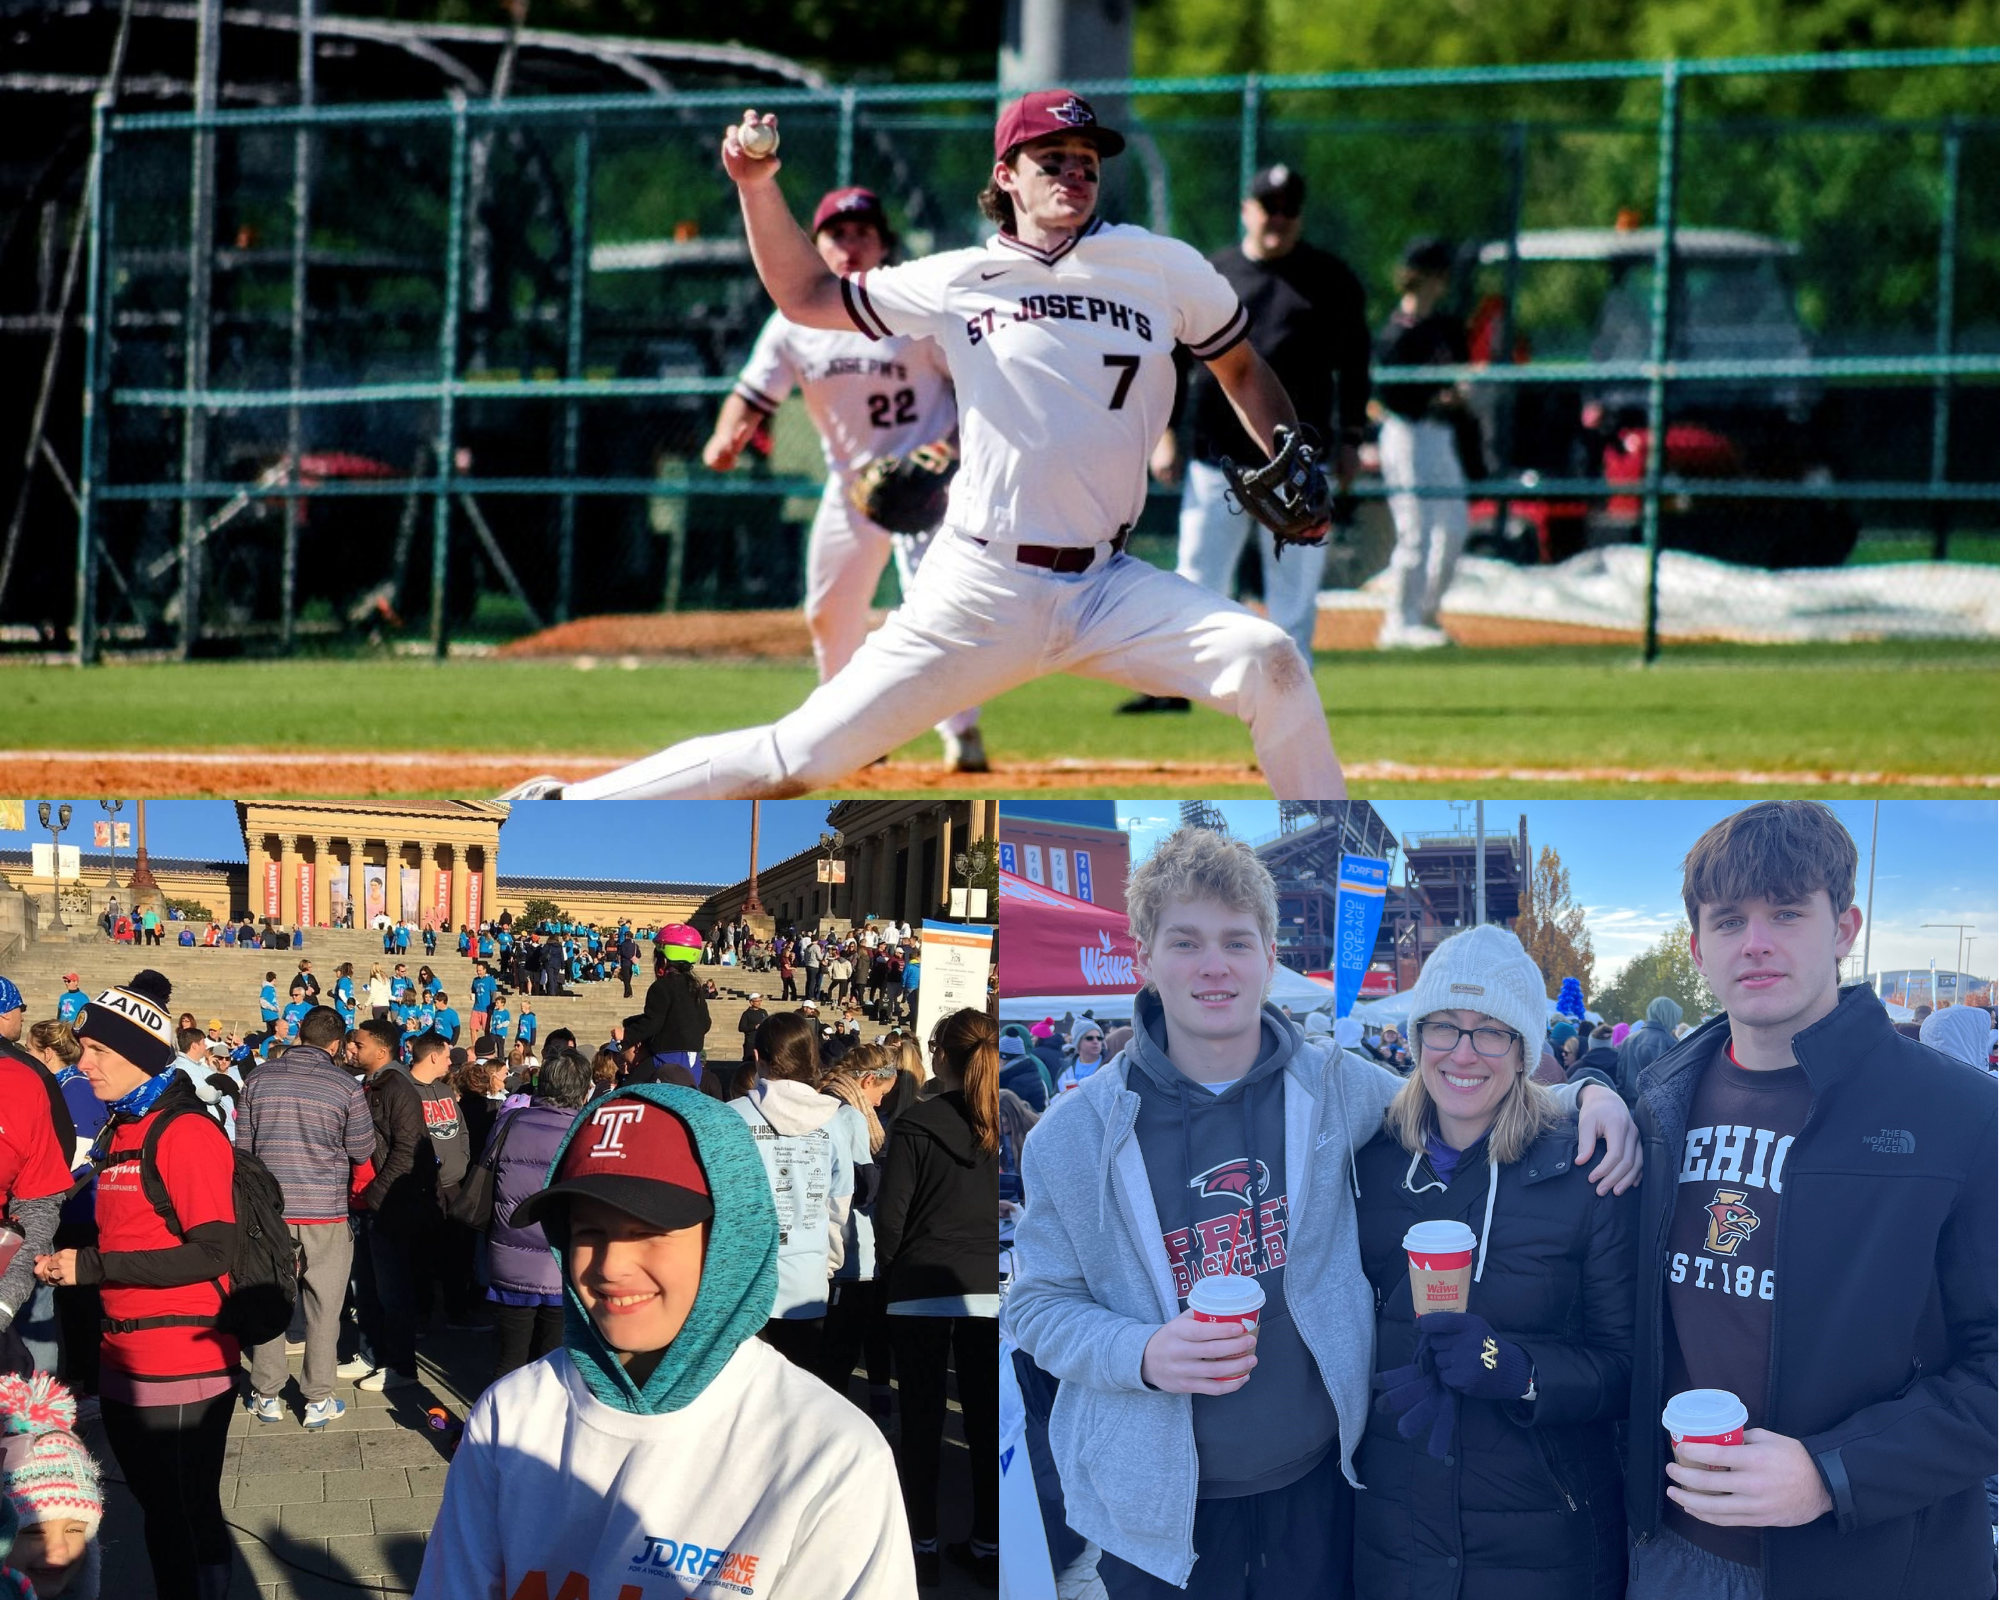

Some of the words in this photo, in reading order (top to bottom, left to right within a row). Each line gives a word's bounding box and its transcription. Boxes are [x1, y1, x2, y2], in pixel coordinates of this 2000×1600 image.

[966, 307, 1007, 346] ST.
[1013, 296, 1153, 342] JOSEPH'S
[1103, 355, 1141, 411] 7
[868, 387, 919, 429] 22
[268, 864, 277, 894] PAINT
[1345, 864, 1372, 876] JDRF
[268, 896, 277, 915] THE
[1344, 899, 1355, 926] AND
[1342, 930, 1355, 969] FOOD
[1352, 902, 1366, 970] BEVERAGE
[1080, 946, 1137, 985] Wawa
[96, 991, 163, 1031] LAND
[422, 1097, 457, 1125] FAU
[1862, 1136, 1899, 1145] NORTH
[1880, 1129, 1900, 1137] THE
[1872, 1145, 1898, 1153] FACE
[1427, 1283, 1458, 1294] Wawa
[1724, 1434, 1733, 1442] 12
[632, 1535, 726, 1577] JDRF
[724, 1552, 760, 1575] ONE
[648, 1568, 672, 1579] WORLD
[672, 1573, 701, 1585] WITHOUT
[720, 1568, 756, 1586] WALK
